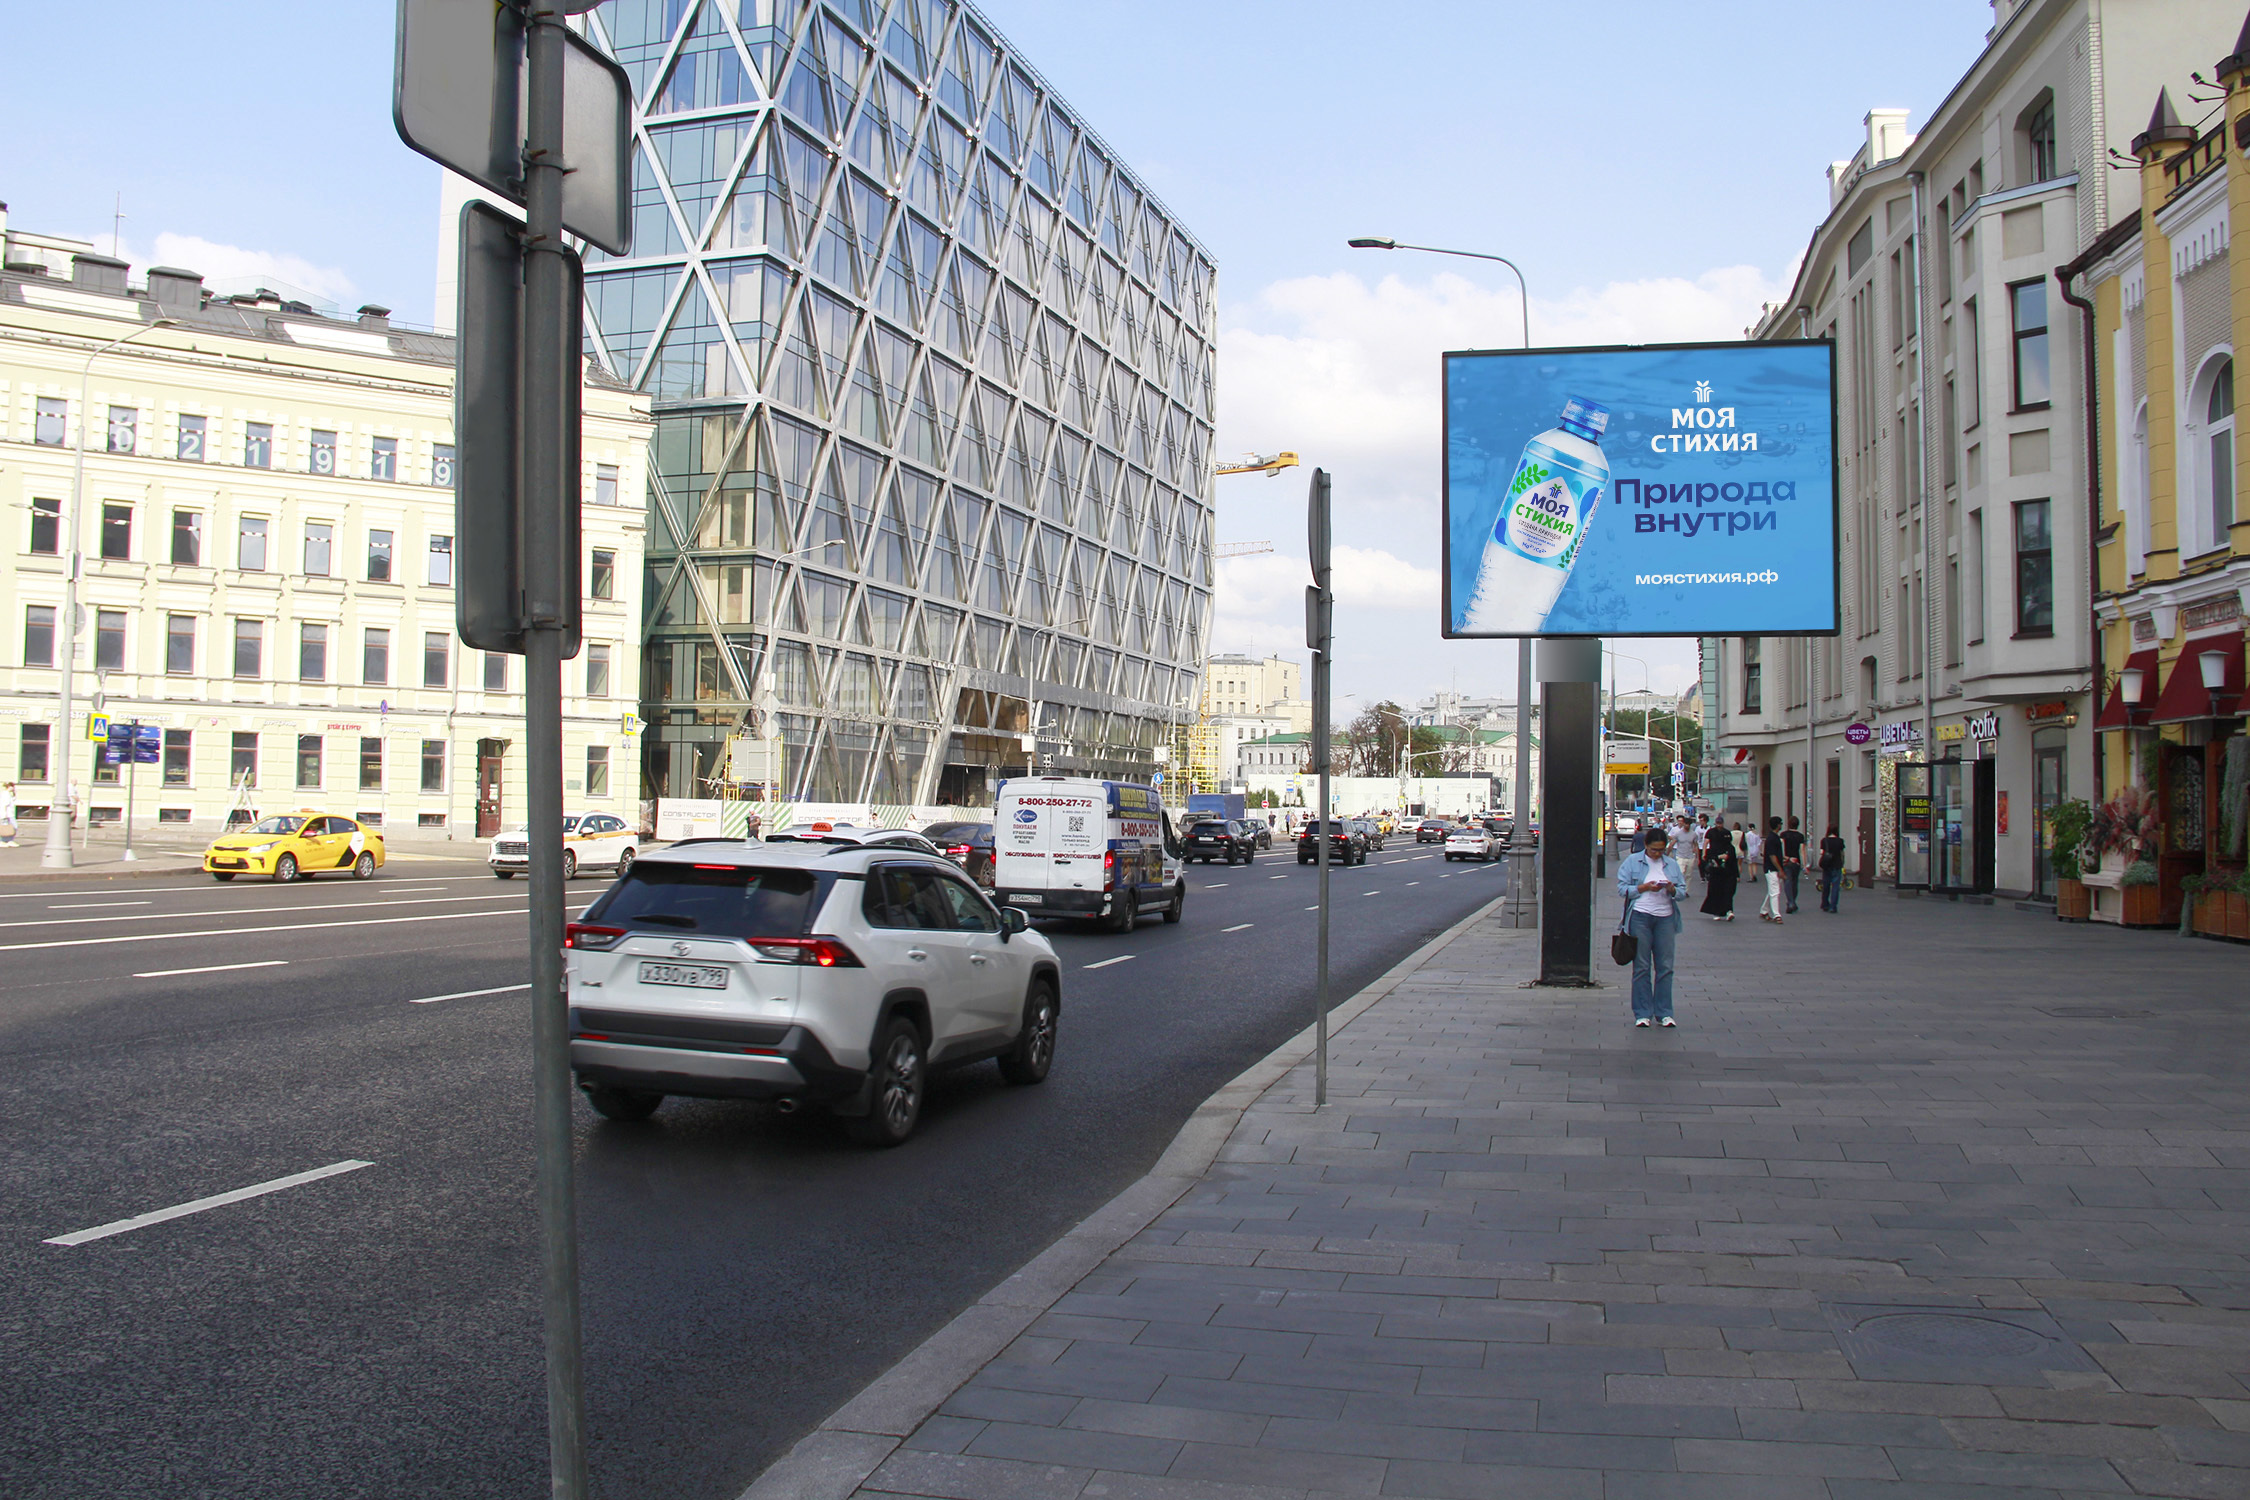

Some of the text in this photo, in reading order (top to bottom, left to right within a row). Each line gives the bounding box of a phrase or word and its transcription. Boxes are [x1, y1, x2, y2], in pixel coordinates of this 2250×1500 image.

[1671, 407, 1735, 429] МОЯ
[1651, 433, 1758, 453] СТИХИЯ
[182, 433, 201, 459] 2
[249, 443, 261, 465] 1
[315, 449, 333, 473] 9
[376, 457, 388, 480] 1
[434, 462, 452, 486] 9
[1530, 492, 1570, 518] МОЯ
[1614, 478, 1797, 509] Природа
[1515, 503, 1575, 536] СТИХИЯ
[1634, 510, 1777, 537] внутри
[1635, 569, 1779, 585] моястихия.рф
[1880, 721, 1909, 746] ЦВЕТЫ
[1970, 711, 1997, 739] cofix
[662, 810, 717, 818] CONSTRUCTOR
[1018, 797, 1093, 808] 8-800-250-27-72
[1121, 822, 1159, 838] 8-800-250-27-72
